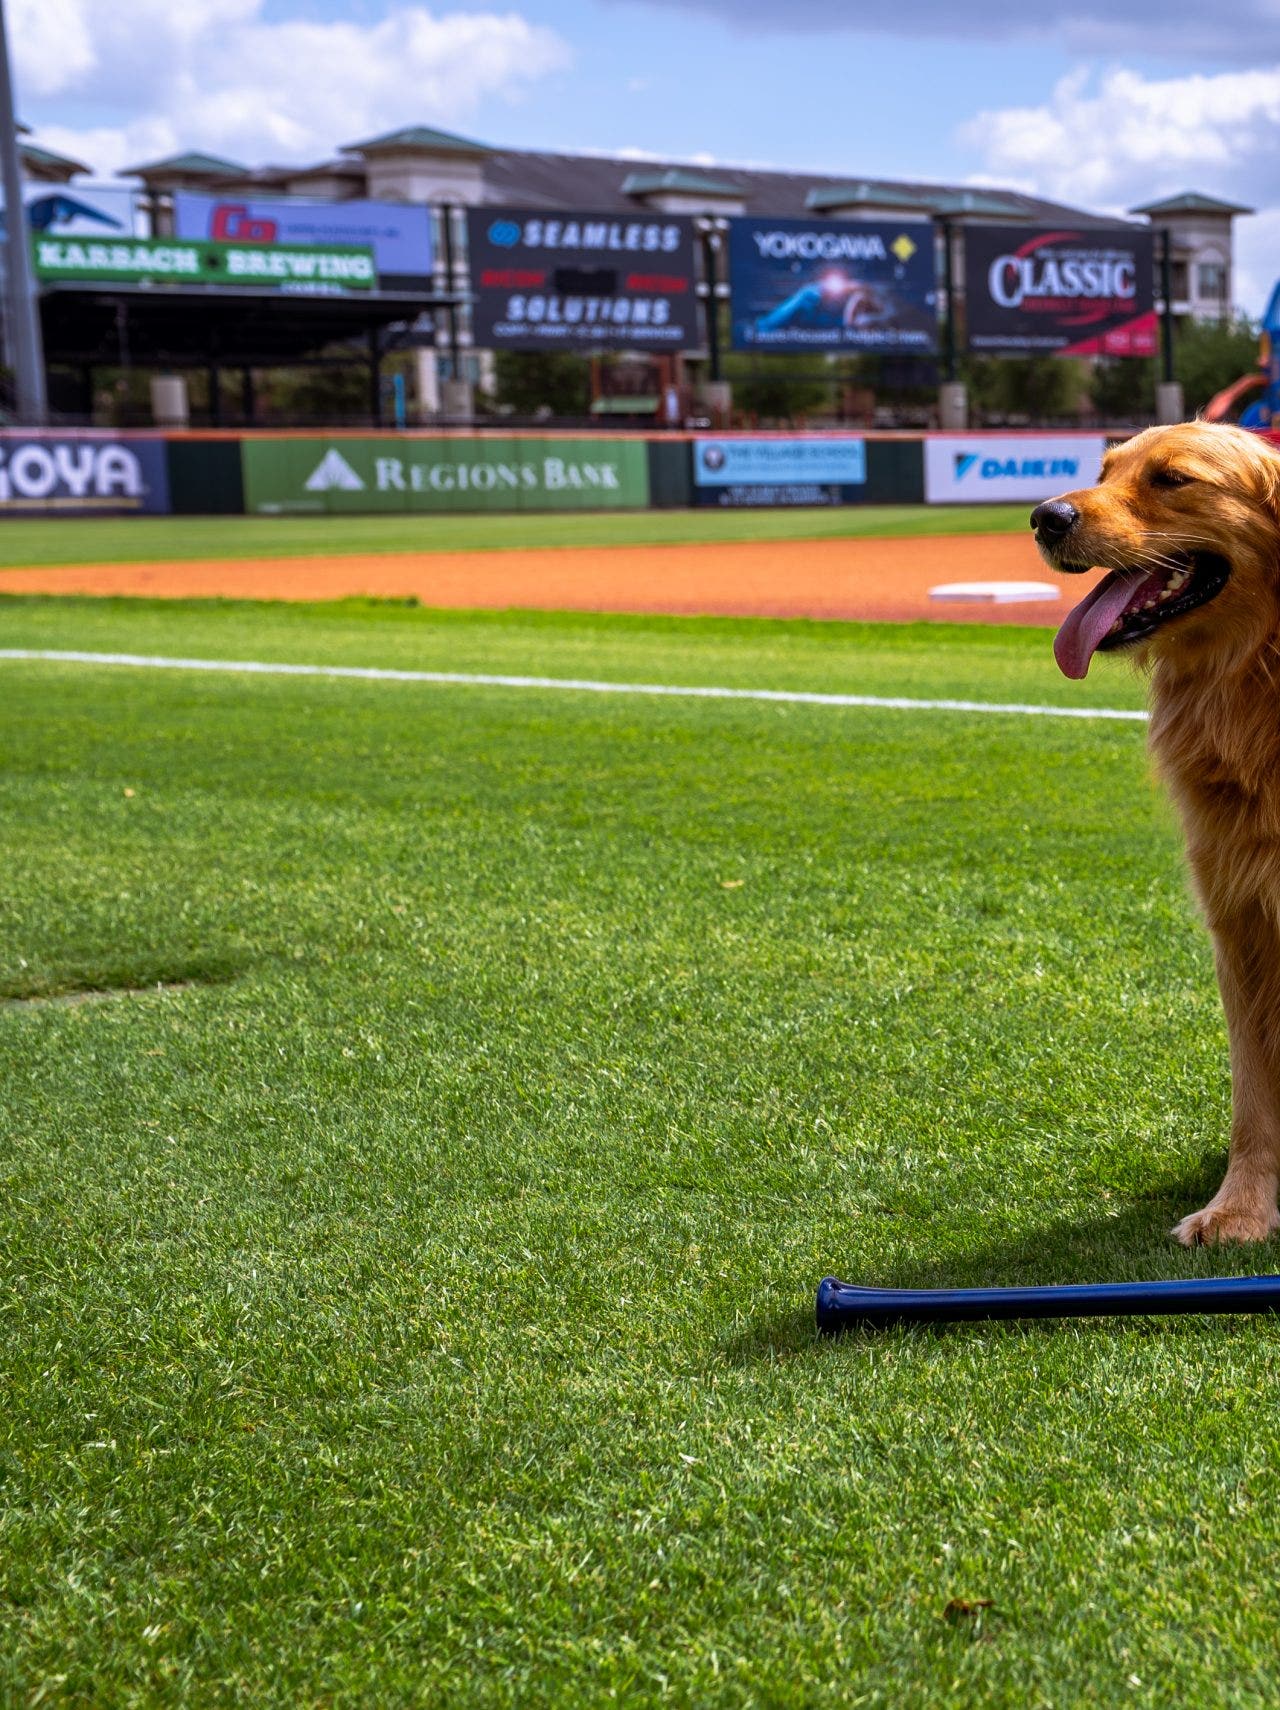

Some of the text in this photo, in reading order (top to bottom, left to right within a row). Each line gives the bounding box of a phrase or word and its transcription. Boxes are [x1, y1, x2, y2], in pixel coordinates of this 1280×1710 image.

[523, 219, 681, 252] SEAMLESS
[753, 231, 887, 260] YOKOGAWA
[38, 241, 375, 280] KARBACH BREWING
[988, 254, 1136, 308] CLASSIC
[507, 295, 670, 325] SOLUTIONS
[0, 445, 143, 500] OYA
[376, 456, 619, 491] REGIONS BANK
[980, 457, 1078, 478] DAIKIN
